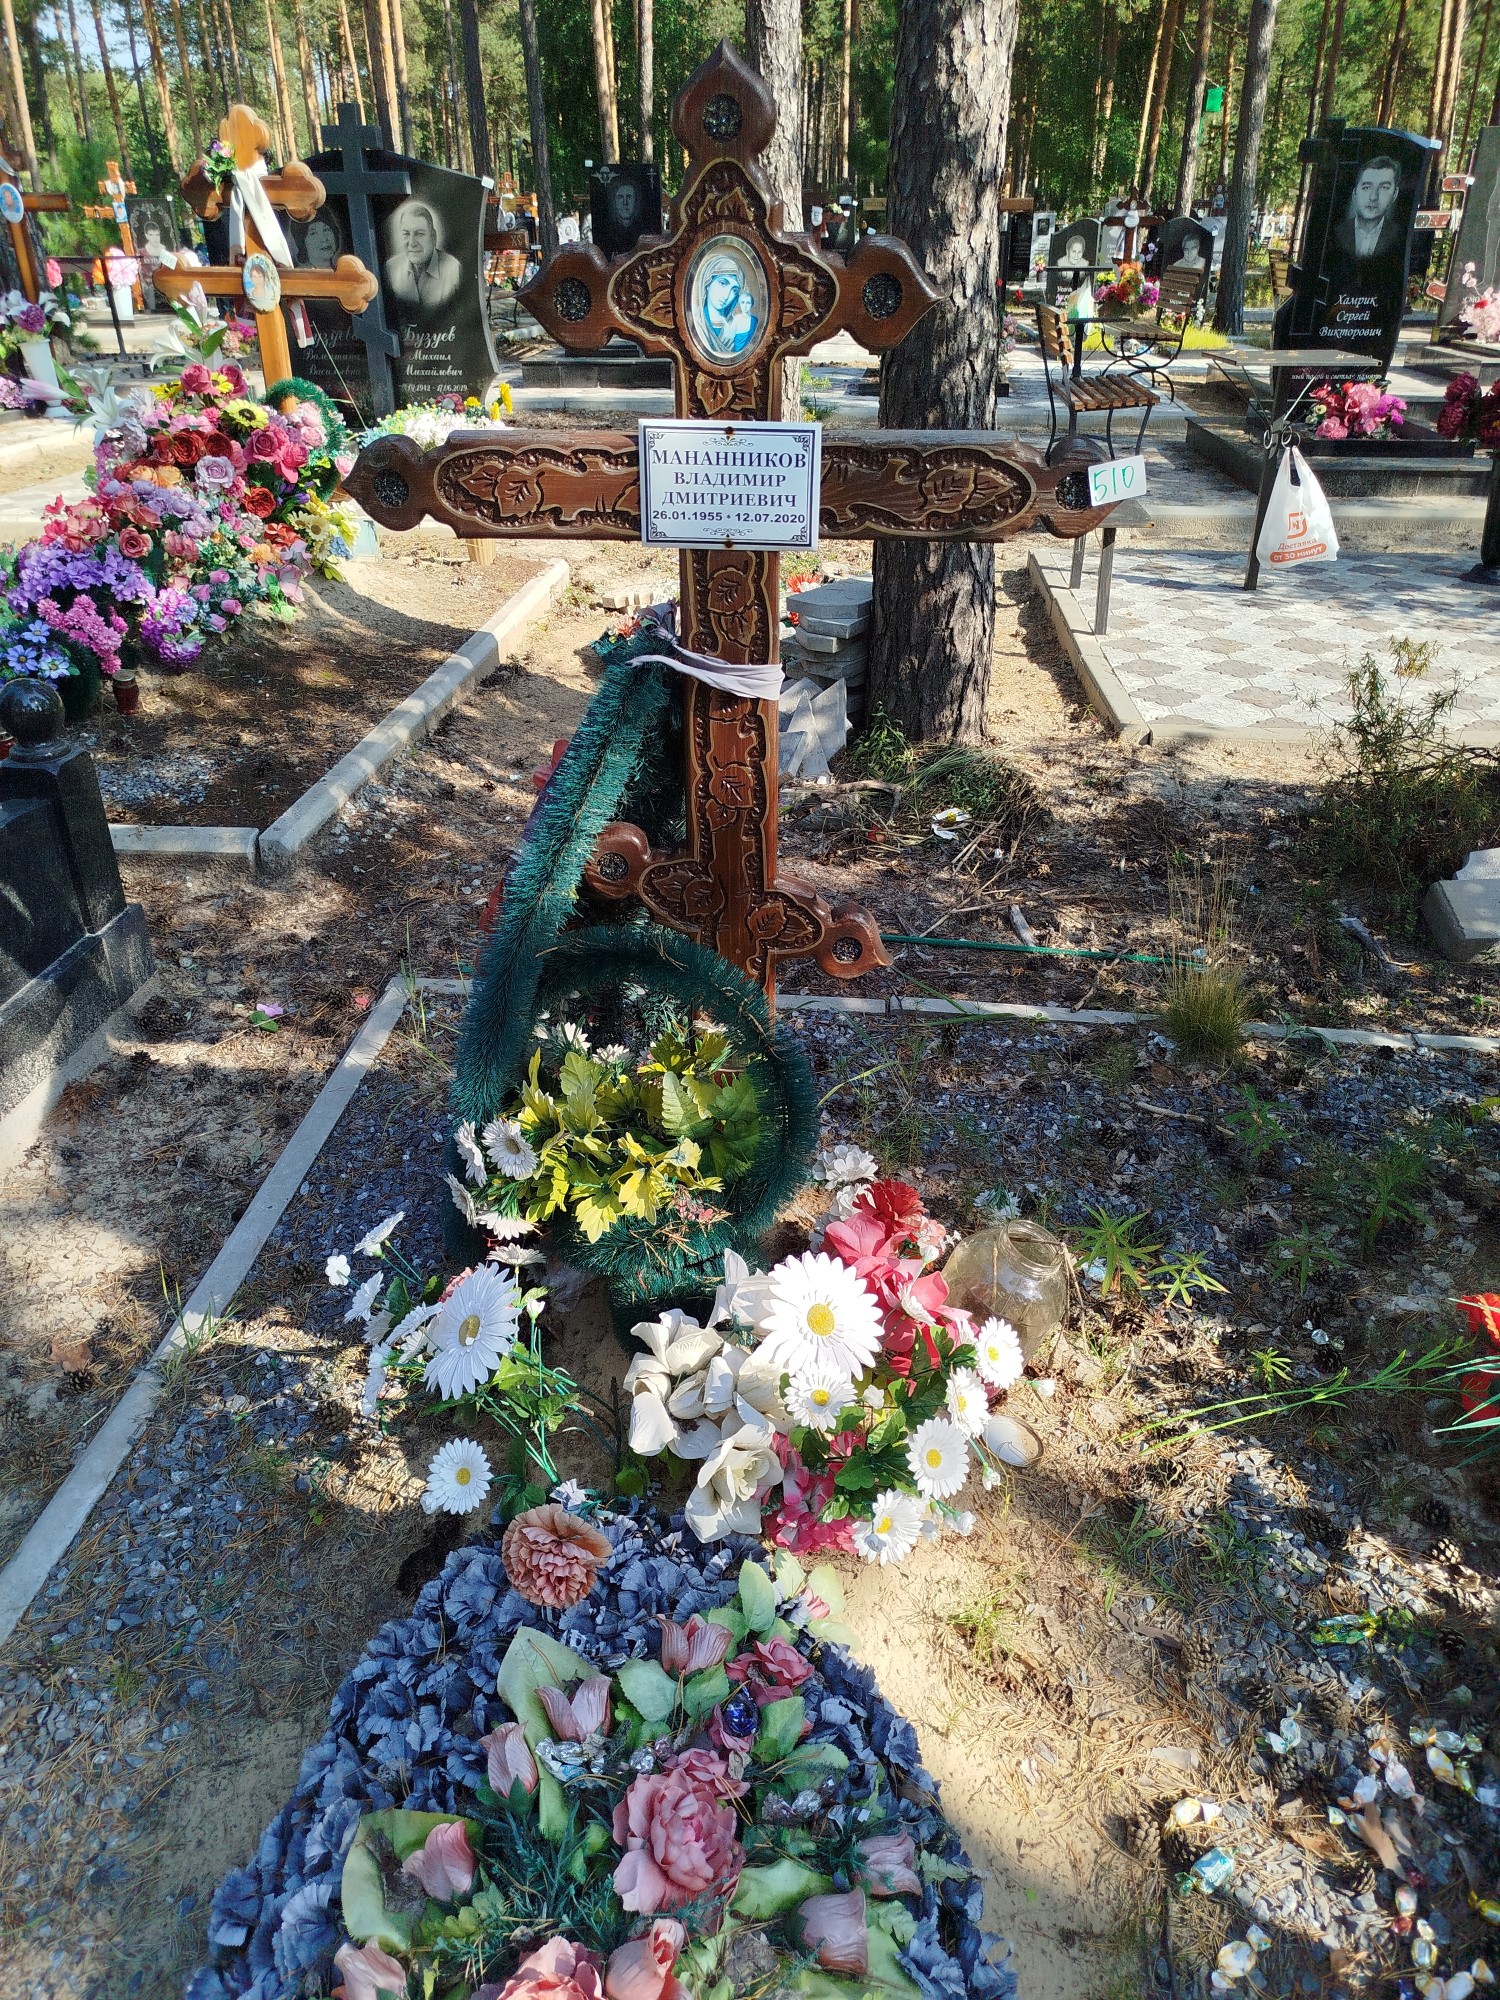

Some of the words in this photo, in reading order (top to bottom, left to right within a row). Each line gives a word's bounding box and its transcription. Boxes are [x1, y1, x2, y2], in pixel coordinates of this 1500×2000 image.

[1335, 294, 1378, 308] Хамрик
[1336, 310, 1370, 324] Сергей
[401, 323, 457, 348] Бузуев
[1318, 326, 1382, 339] Викторович
[408, 350, 452, 361] Михаил
[403, 366, 463, 377] Михайлович
[652, 449, 807, 468] МАНАННИКОВ
[674, 471, 787, 488] ВЛАДИМИР
[1093, 465, 1135, 502] 510
[661, 491, 798, 507] ДМИТРИЕВИЧ
[652, 510, 723, 522] 26.01.1955
[735, 512, 805, 524] 12.07.2020
[1278, 539, 1316, 550] Доставка
[1284, 552, 1295, 560] 30
[1297, 546, 1323, 558] минут
